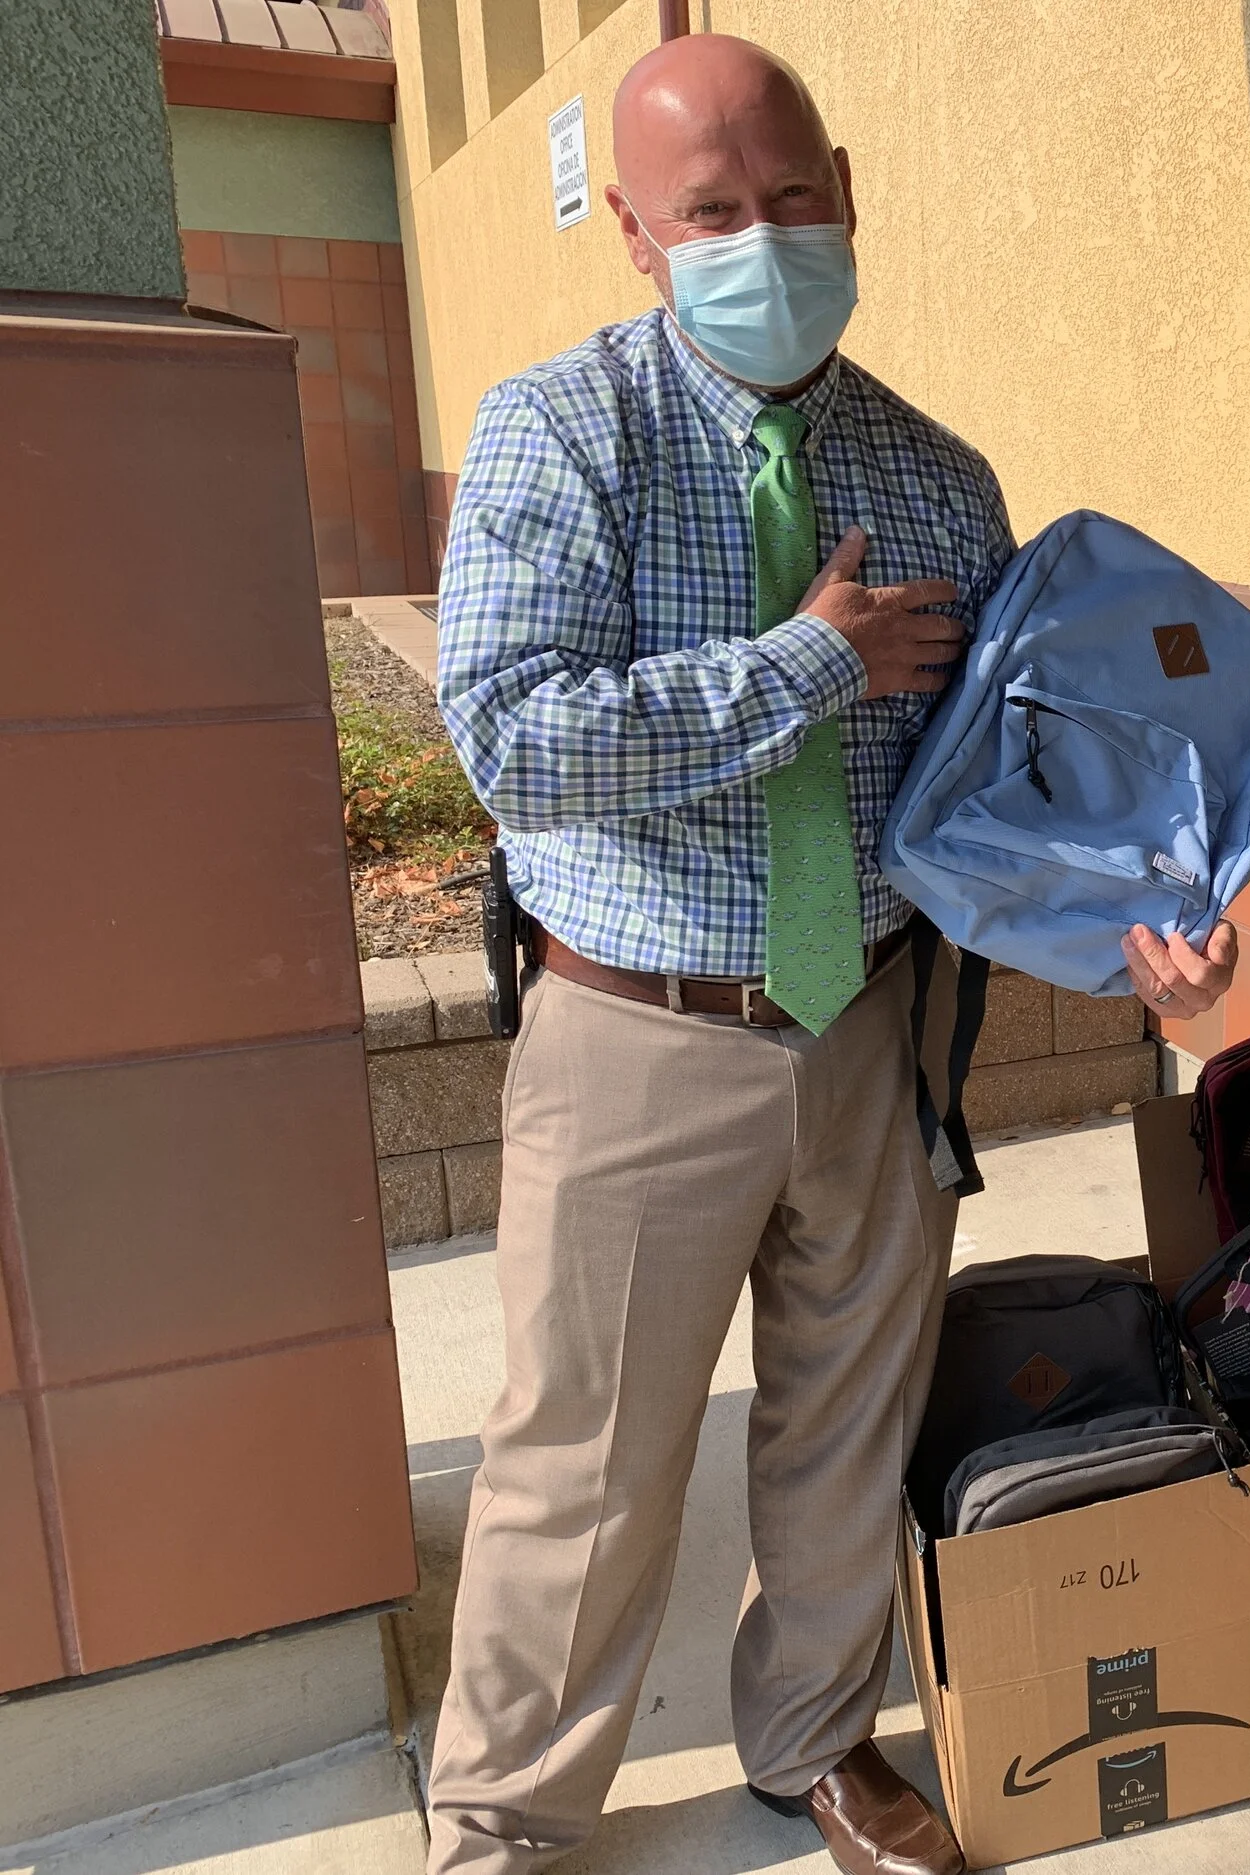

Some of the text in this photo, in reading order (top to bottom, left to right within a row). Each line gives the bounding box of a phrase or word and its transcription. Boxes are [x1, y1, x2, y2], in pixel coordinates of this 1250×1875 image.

[550, 104, 582, 139] ADMINISTRATION
[560, 132, 573, 155] OFFICE
[1060, 1558, 1140, 1589] 170 Z17
[1096, 1650, 1149, 1675] prime
[1096, 1692, 1132, 1705] listening
[1133, 1688, 1150, 1696] free
[1107, 1801, 1123, 1810] free
[1125, 1792, 1160, 1806] listening
